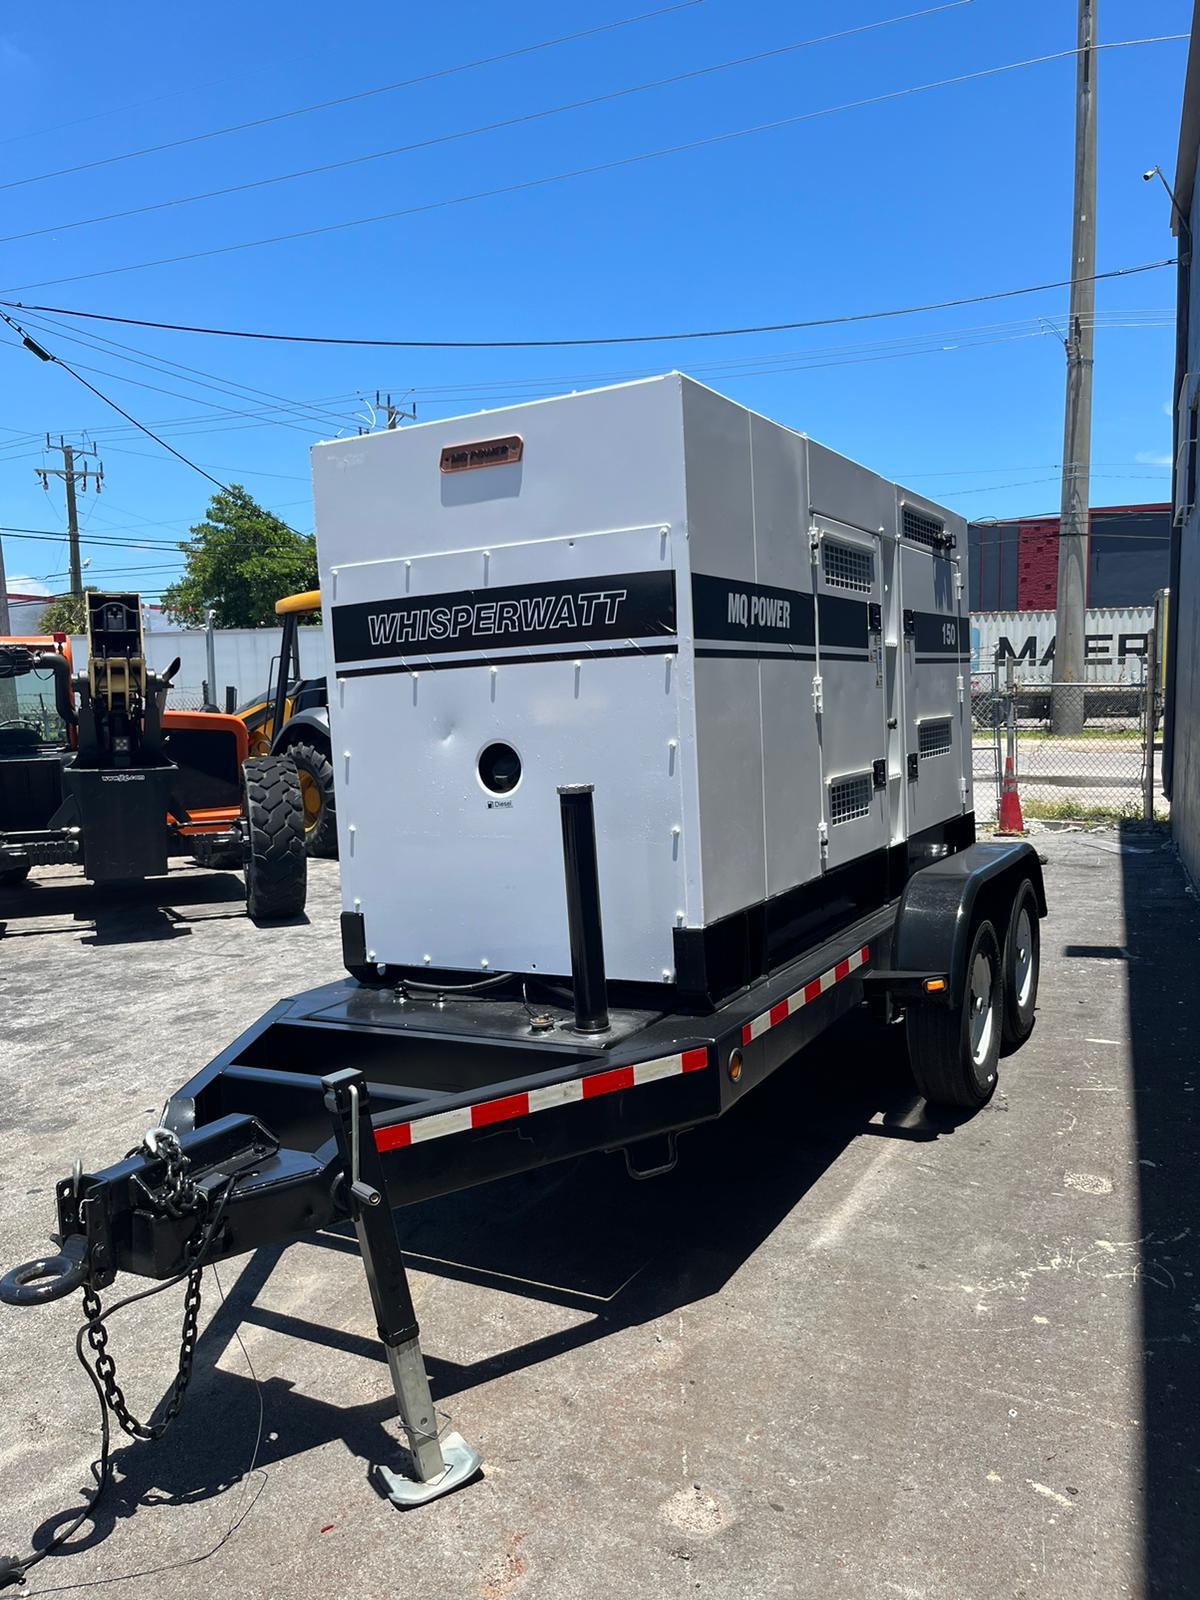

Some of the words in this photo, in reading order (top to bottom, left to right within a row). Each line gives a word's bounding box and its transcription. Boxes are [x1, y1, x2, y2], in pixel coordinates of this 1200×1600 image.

[368, 590, 626, 645] WHISPERWATT
[728, 593, 748, 629] MQ
[751, 595, 790, 629] POWER
[942, 623, 955, 645] 150
